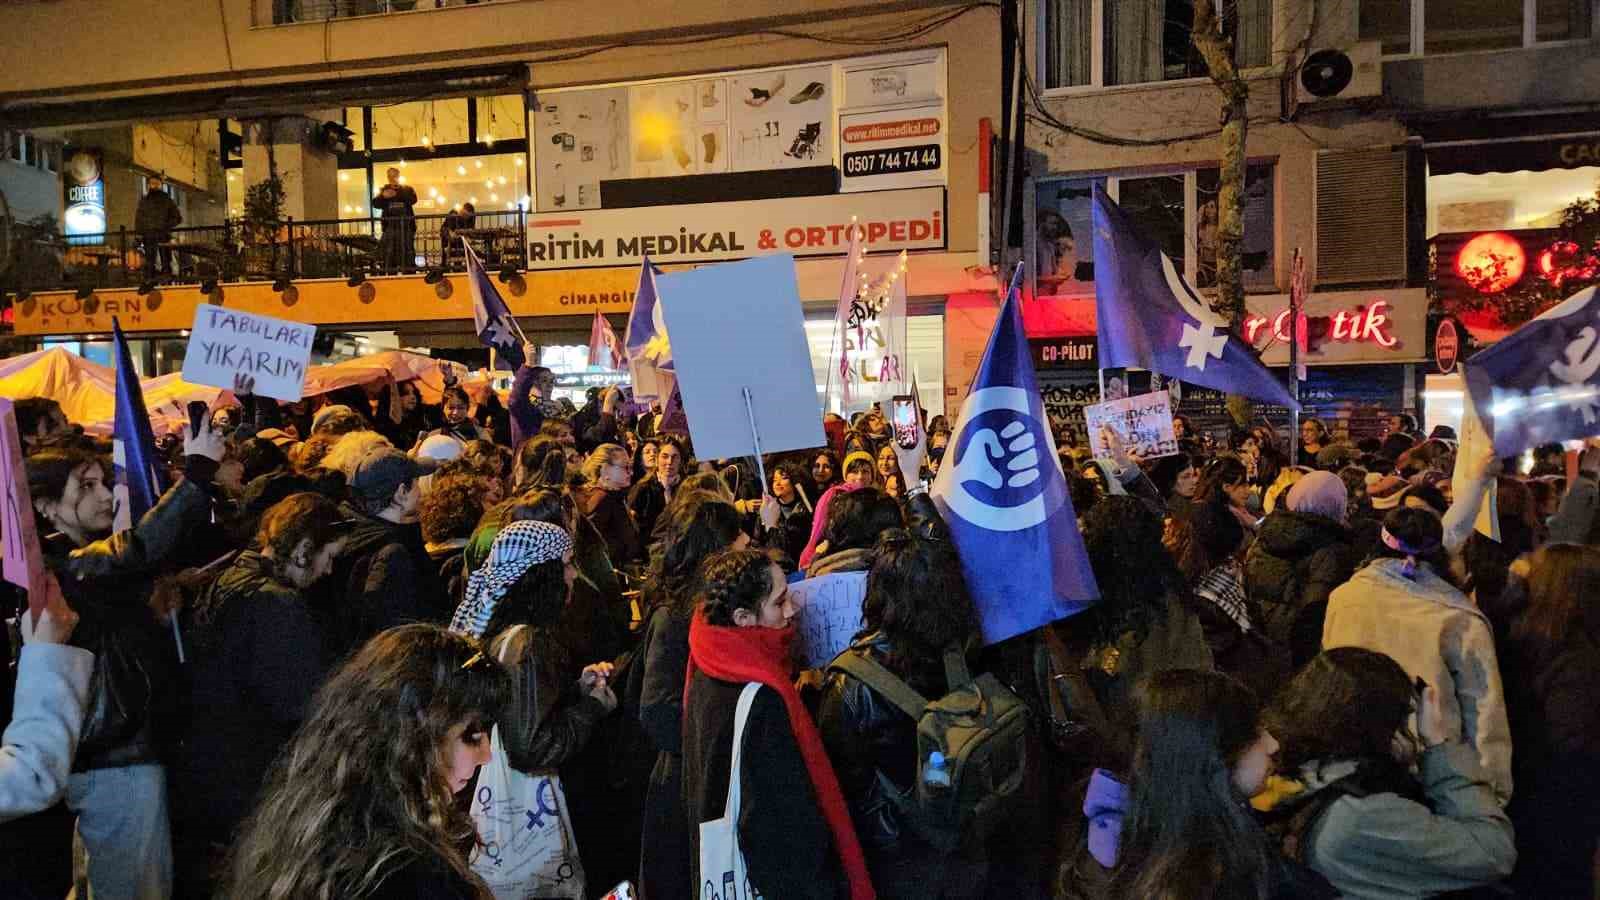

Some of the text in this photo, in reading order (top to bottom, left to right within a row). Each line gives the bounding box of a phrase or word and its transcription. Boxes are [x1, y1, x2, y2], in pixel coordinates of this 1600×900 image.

[847, 148, 937, 173] 0507 744 74 44
[69, 186, 98, 201] COFFEE
[529, 211, 942, 262] RİTİM MEDİKAL & ORTOPEDİ
[201, 341, 303, 383] YIKARIM
[1042, 341, 1094, 361] CO-PİLOT
